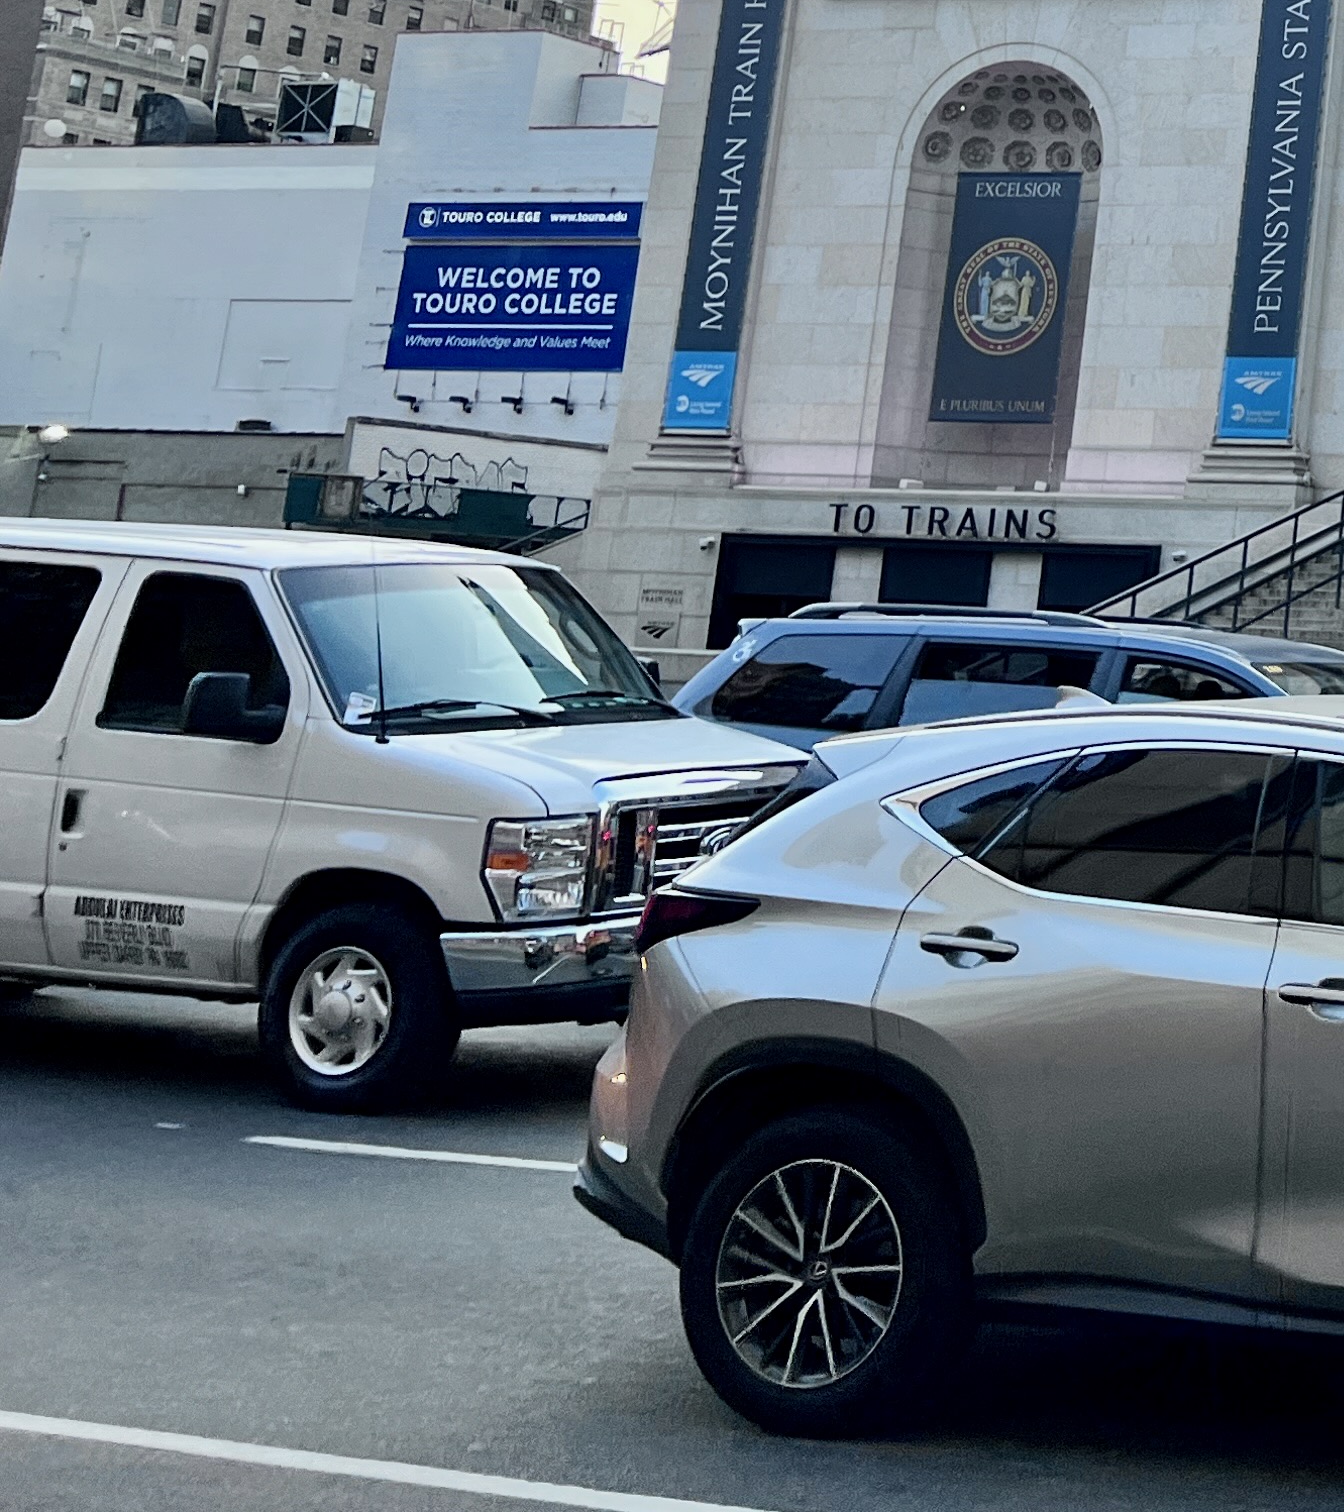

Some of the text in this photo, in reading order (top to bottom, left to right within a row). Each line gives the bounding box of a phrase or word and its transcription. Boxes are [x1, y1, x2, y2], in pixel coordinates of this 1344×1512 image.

[699, 137, 747, 331] MOYNIHAN
[728, 22, 764, 125] TRAIN
[975, 181, 1062, 198] EXCELSIOR
[1253, 71, 1305, 334] PENNSYLVANIA
[442, 211, 483, 223] TOURO
[486, 211, 541, 223] COLLEGE
[550, 210, 628, 223] www.touro.edu
[437, 267, 601, 289] WELCOME TO
[413, 293, 618, 315] TOURO COLLEGE
[405, 334, 611, 350] Where Knowledge and Values Meet
[950, 399, 1005, 412] PLURIBUS
[1007, 399, 1045, 412] UNUM
[829, 503, 1057, 539] TO TRAINS
[119, 899, 185, 926] ENTERPRISES
